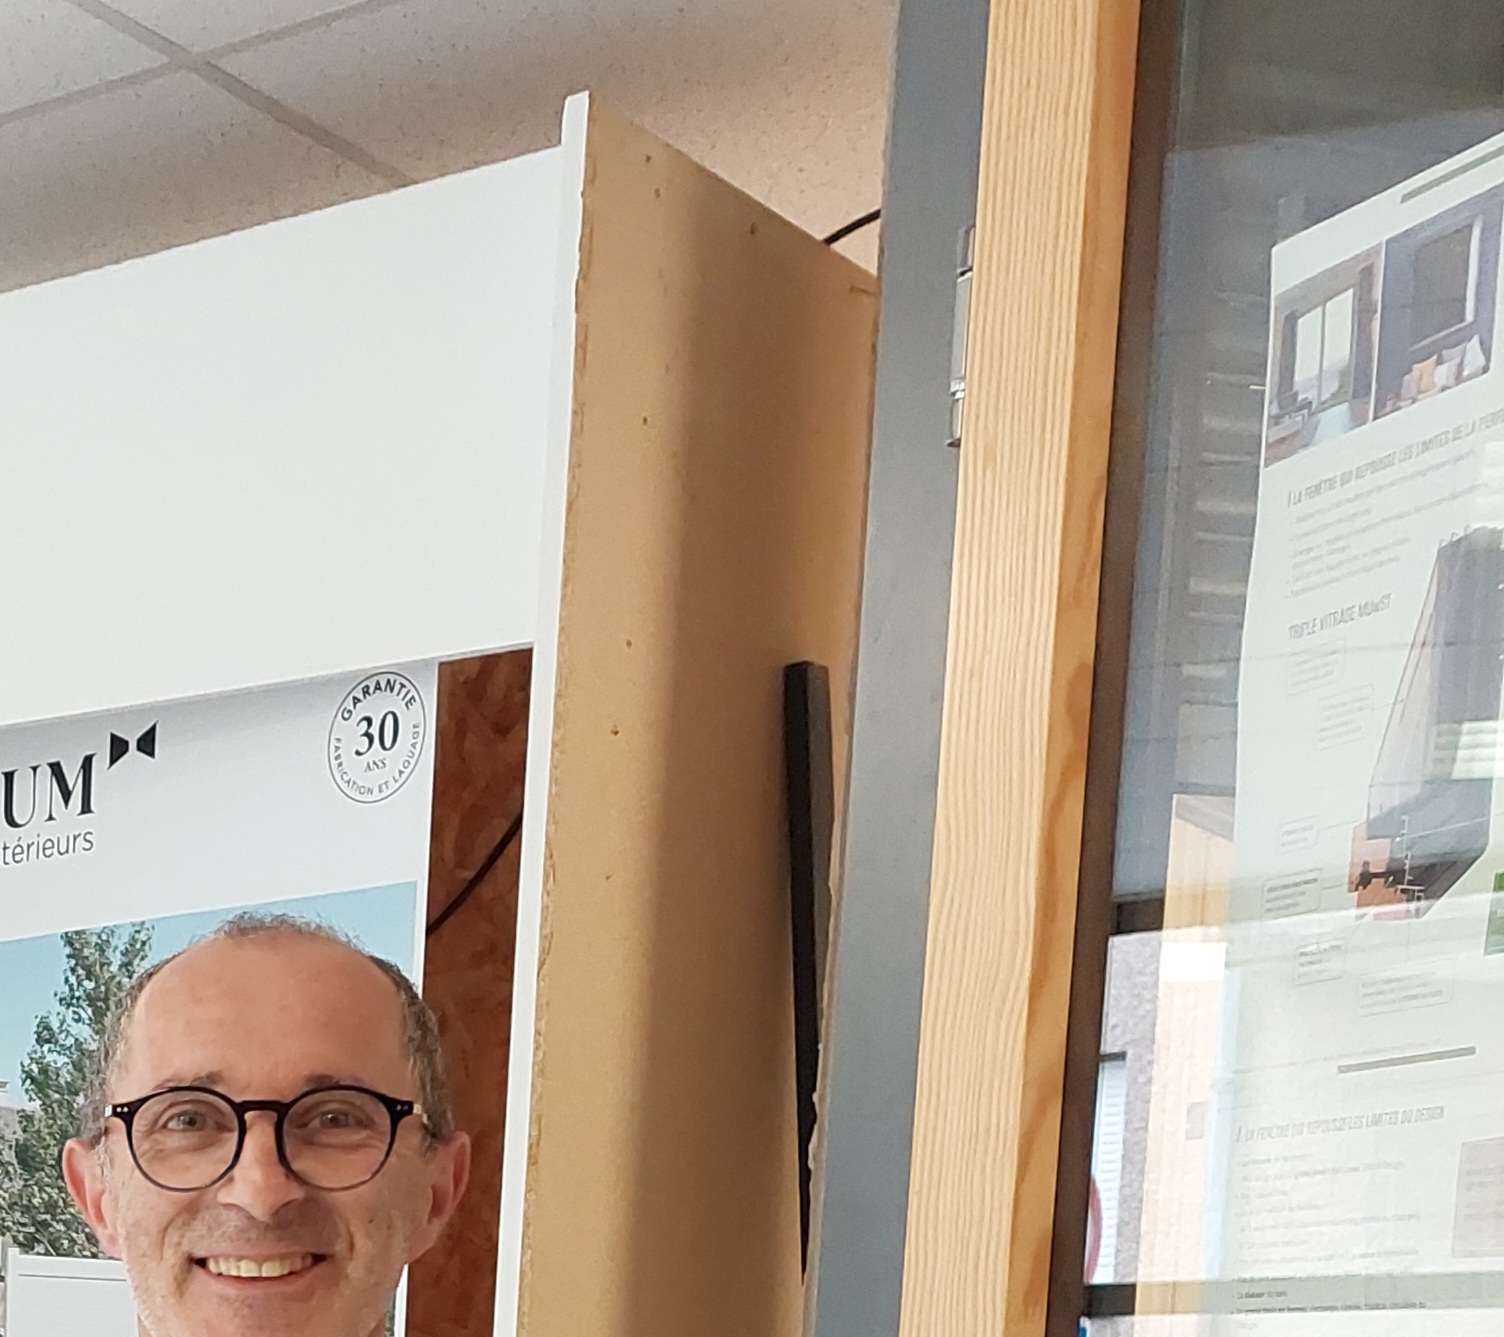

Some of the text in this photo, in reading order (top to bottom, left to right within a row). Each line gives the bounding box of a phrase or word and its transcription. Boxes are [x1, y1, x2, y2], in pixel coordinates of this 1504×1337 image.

[1288, 617, 1317, 640] TRIPLE
[1319, 605, 1356, 630] VITRAGE
[340, 677, 417, 722] GARANTIE
[354, 710, 400, 757] 30
[334, 722, 421, 796] FABRICATION ET LAQUAGE
[364, 757, 387, 773] ANS
